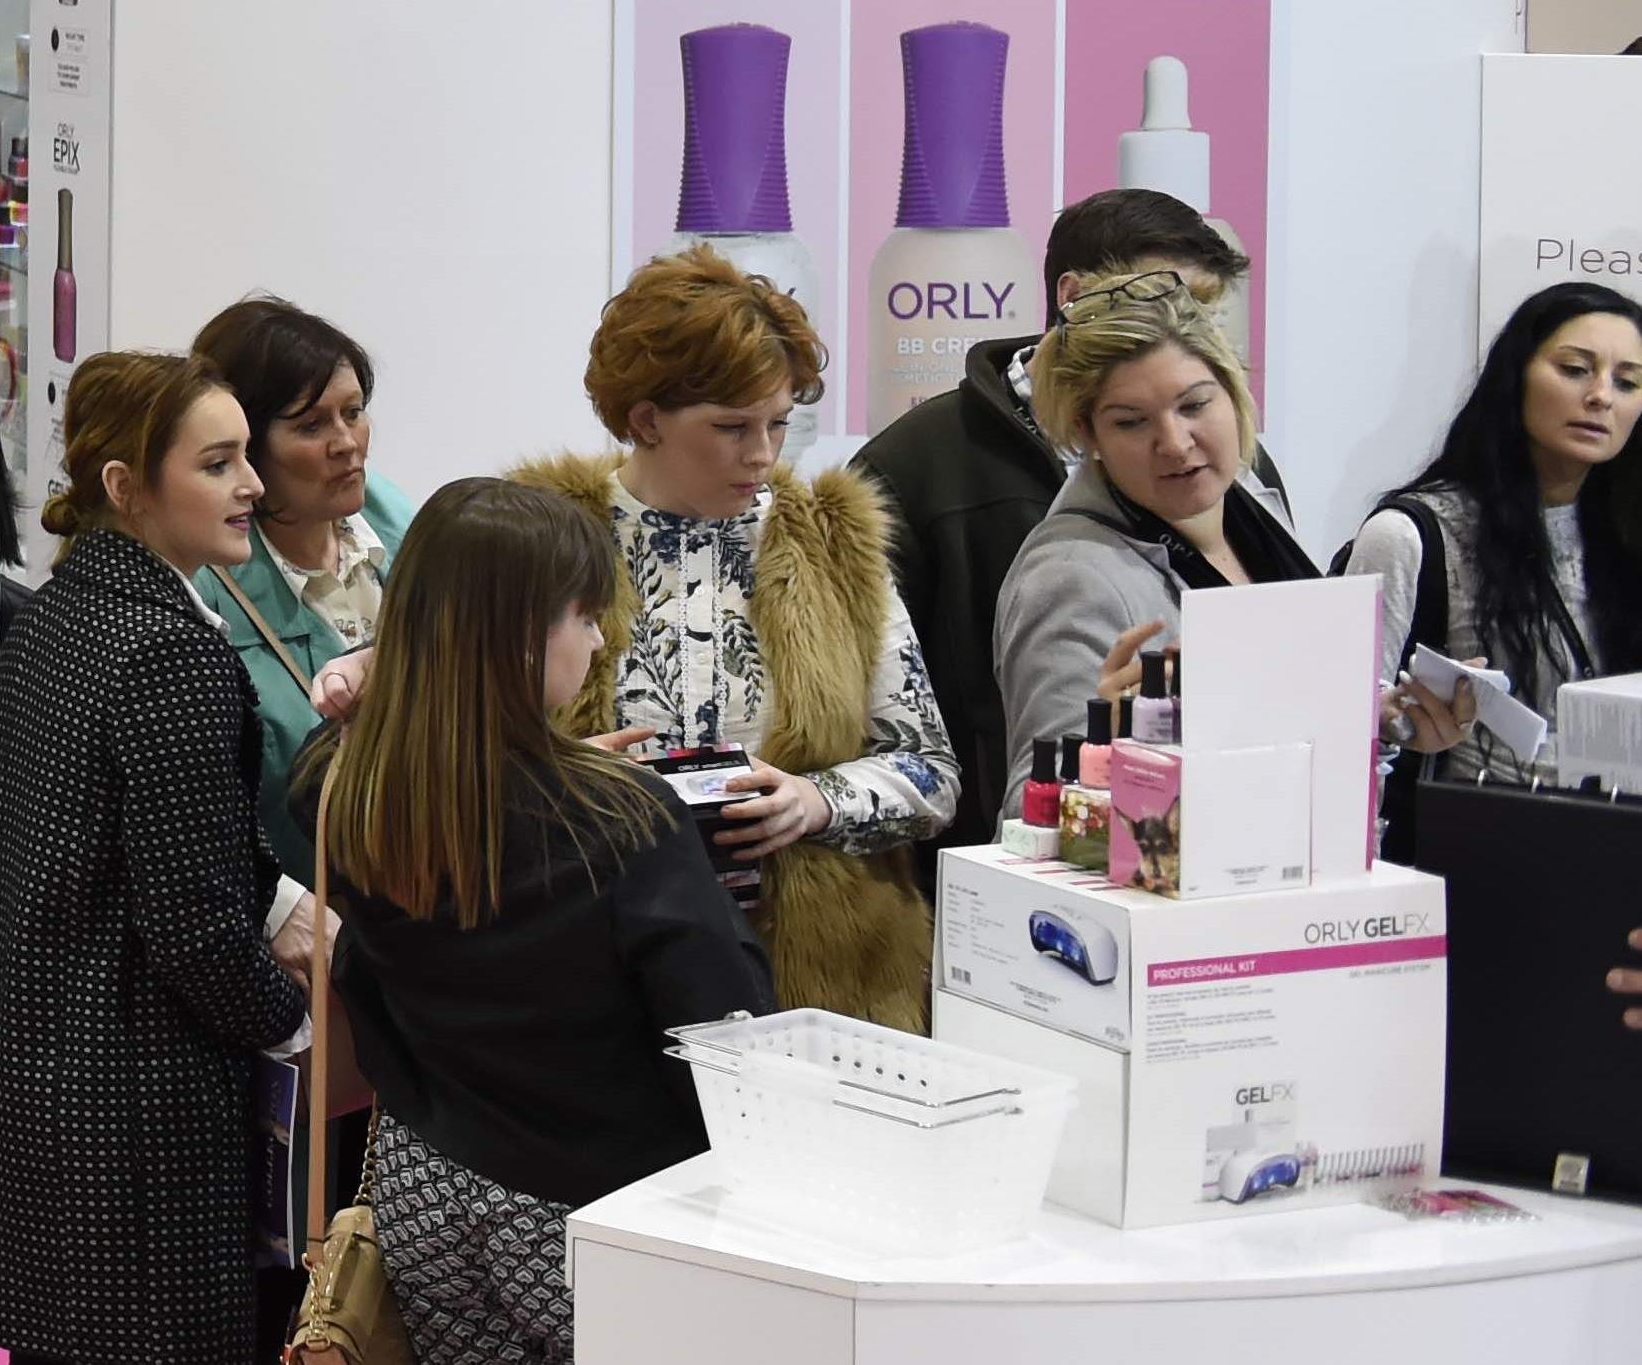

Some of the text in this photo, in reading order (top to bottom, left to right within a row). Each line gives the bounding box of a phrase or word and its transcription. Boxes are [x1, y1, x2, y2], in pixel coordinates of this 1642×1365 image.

[53, 137, 81, 172] EPIX
[887, 281, 1016, 321] ORLY
[896, 338, 925, 355] BB
[1303, 919, 1361, 945] ORLY
[1152, 959, 1257, 982] PROFESSIONAL KIT
